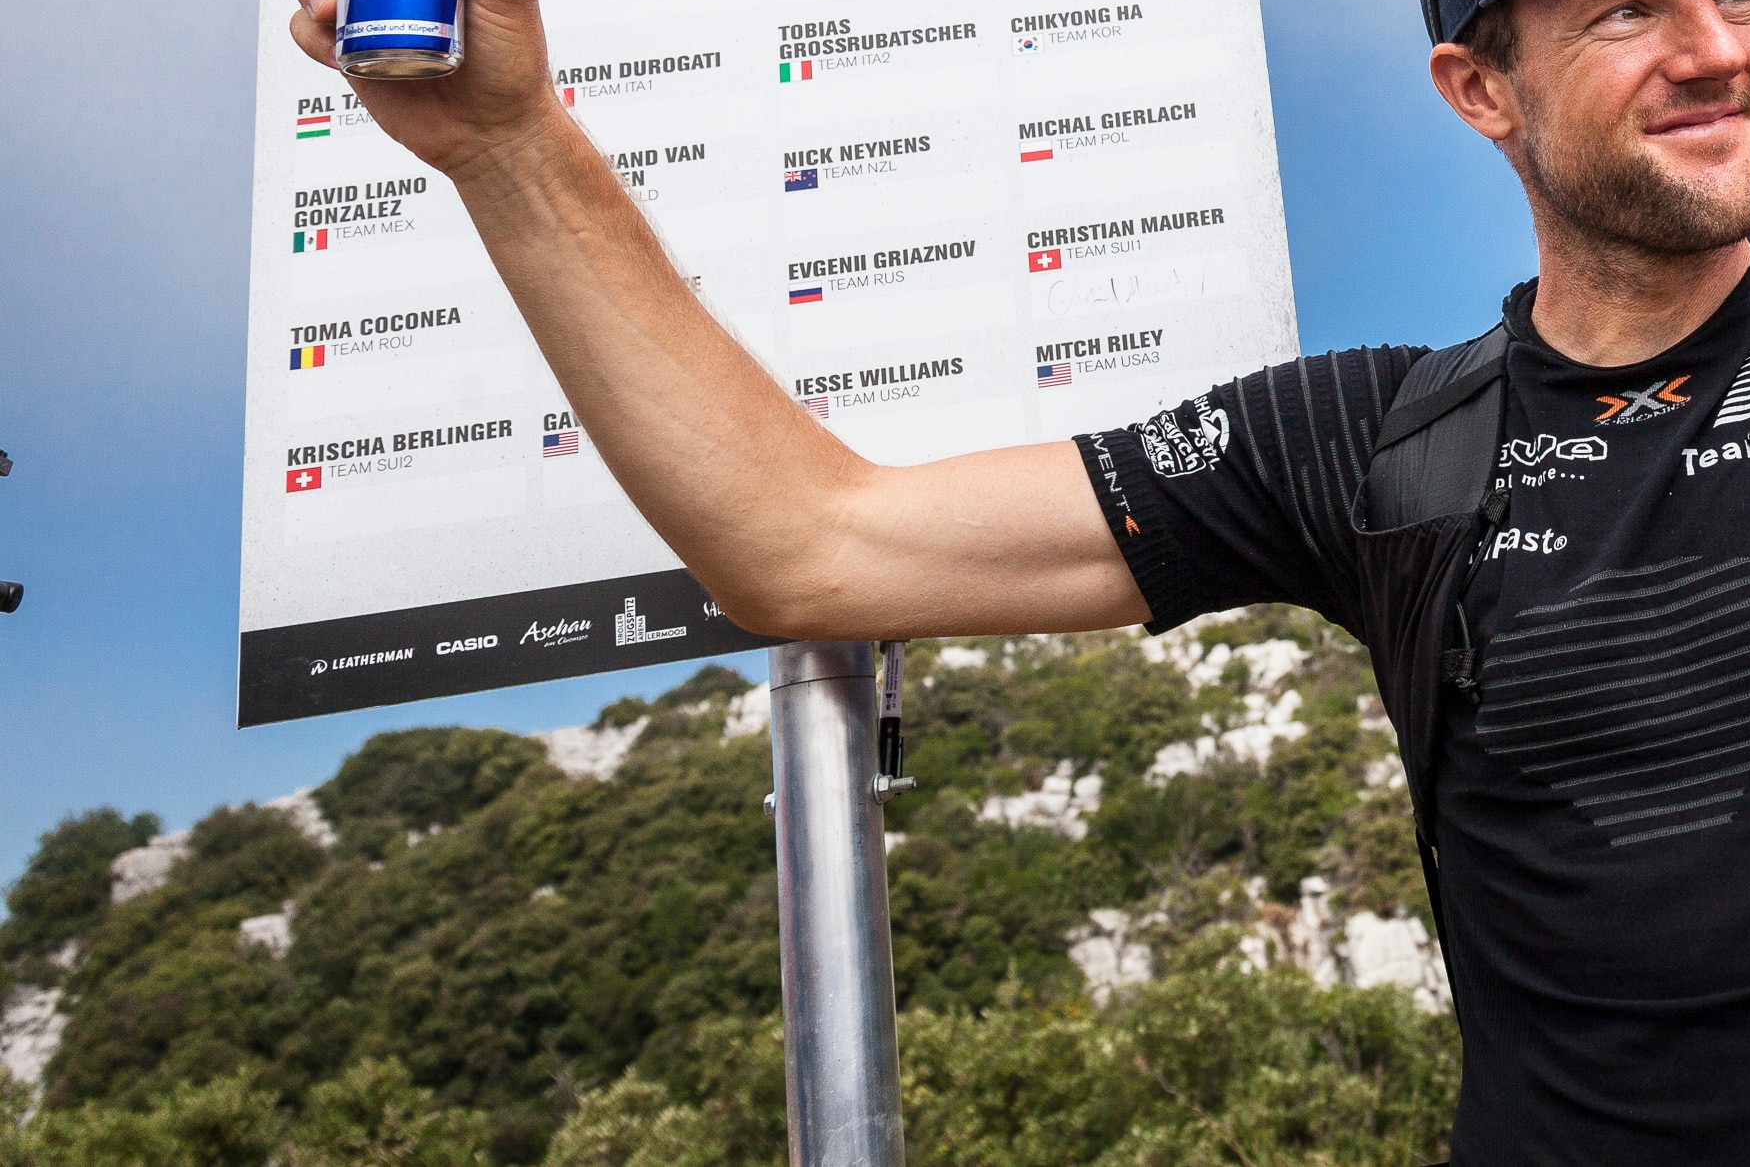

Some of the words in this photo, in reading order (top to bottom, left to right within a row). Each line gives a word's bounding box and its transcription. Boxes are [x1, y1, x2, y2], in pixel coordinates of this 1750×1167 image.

[366, 24, 386, 33] Geist
[1011, 7, 1111, 33] CHIKYONG
[1117, 4, 1143, 21] HA
[778, 19, 851, 41] TOBIAS
[1048, 30, 1087, 44] TEAM
[1091, 26, 1122, 40] KOR
[779, 23, 977, 60] GROSSRUBATSCHER
[619, 52, 721, 79] DUROGATI
[817, 57, 857, 71] TEAM
[861, 52, 891, 67] ITA2
[580, 83, 621, 99] TEAM
[625, 80, 653, 93] ITA1
[298, 96, 335, 115] PAL
[1019, 116, 1095, 139] MICHAL
[1101, 103, 1197, 130] GIERLACH
[783, 148, 833, 169] NICK
[840, 135, 931, 161] NEYNENS
[1056, 136, 1096, 150] TEAM
[1100, 132, 1130, 146] POL
[665, 144, 705, 163] VAN
[822, 166, 863, 180] TEAM
[868, 161, 897, 176] NZL
[295, 186, 358, 208] DAVID
[366, 176, 427, 198] LIANO
[294, 200, 401, 228] GONZALEZ
[334, 223, 375, 239] TEAM
[380, 219, 415, 234] MEX
[1027, 223, 1135, 250] CHRISTIAN
[1141, 208, 1224, 238] MAURER
[1066, 243, 1106, 260] TEAM
[1111, 238, 1142, 254] SUI1
[788, 255, 867, 281] EVGENII
[874, 240, 976, 270] GRIAZNOV
[828, 276, 870, 291] TEAM
[874, 271, 905, 286] RUS
[291, 322, 352, 345] TOMA
[360, 307, 461, 336] COCONEA
[331, 341, 374, 356] TEAM
[379, 336, 413, 351] ROU
[1036, 339, 1100, 363] MITCH
[1108, 329, 1164, 354] RILEY
[859, 357, 964, 388] WILLIAMS
[1076, 359, 1118, 374] TEAM
[1124, 351, 1160, 368] USA3
[834, 392, 875, 408] TEAM
[880, 386, 920, 402] USA2
[288, 437, 385, 467] KRISCHA
[394, 419, 512, 452] BERLINGER
[328, 462, 372, 478] TEAM
[377, 456, 413, 472] SUI2
[519, 618, 593, 645] Aschau
[626, 599, 635, 642] ZUGSPITZ
[436, 634, 499, 656] CASIO
[647, 628, 685, 640] LERMOOS
[332, 647, 414, 670] LEATHERMAN
